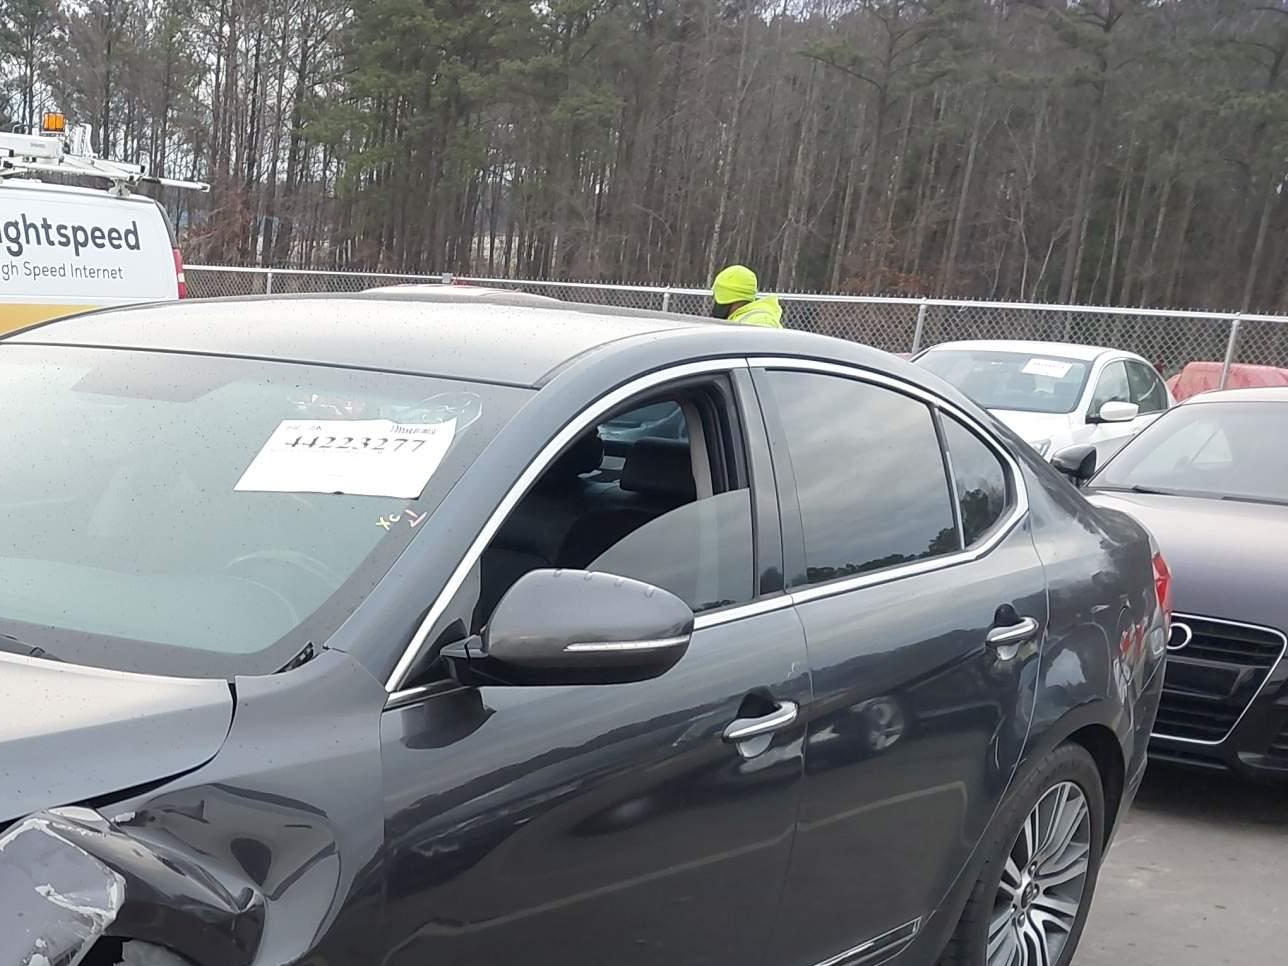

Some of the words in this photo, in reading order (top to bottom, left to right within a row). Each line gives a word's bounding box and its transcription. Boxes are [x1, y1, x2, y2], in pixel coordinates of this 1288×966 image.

[23, 261, 66, 280] Speed
[70, 263, 124, 280] Internet
[285, 435, 427, 452] 44223277
